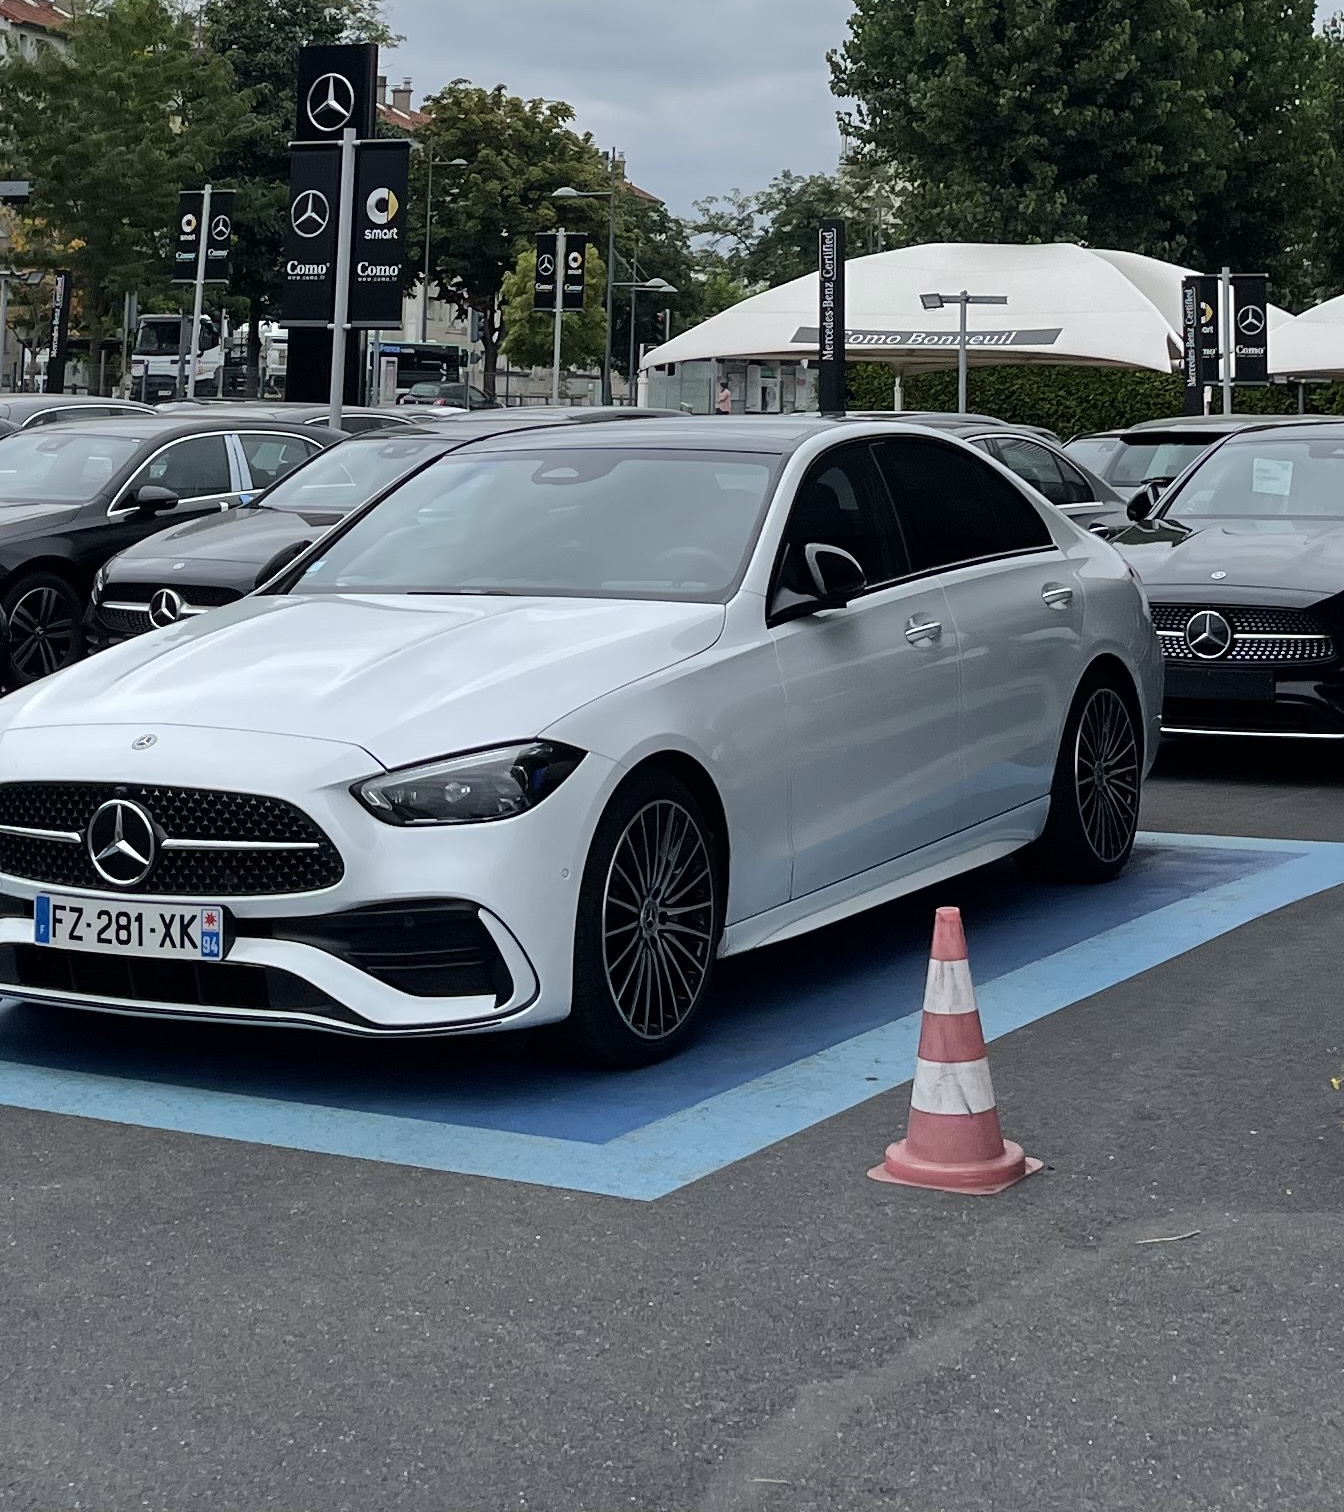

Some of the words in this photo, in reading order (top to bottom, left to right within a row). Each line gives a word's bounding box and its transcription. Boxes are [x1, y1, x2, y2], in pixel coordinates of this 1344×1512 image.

[364, 228, 398, 239] smart
[286, 260, 327, 275] Como
[357, 262, 399, 276] Como
[822, 231, 834, 278] Certified
[822, 281, 834, 361] Mercedes-Benz
[52, 904, 199, 950] FZ-281-XK
[202, 937, 219, 955] 94
